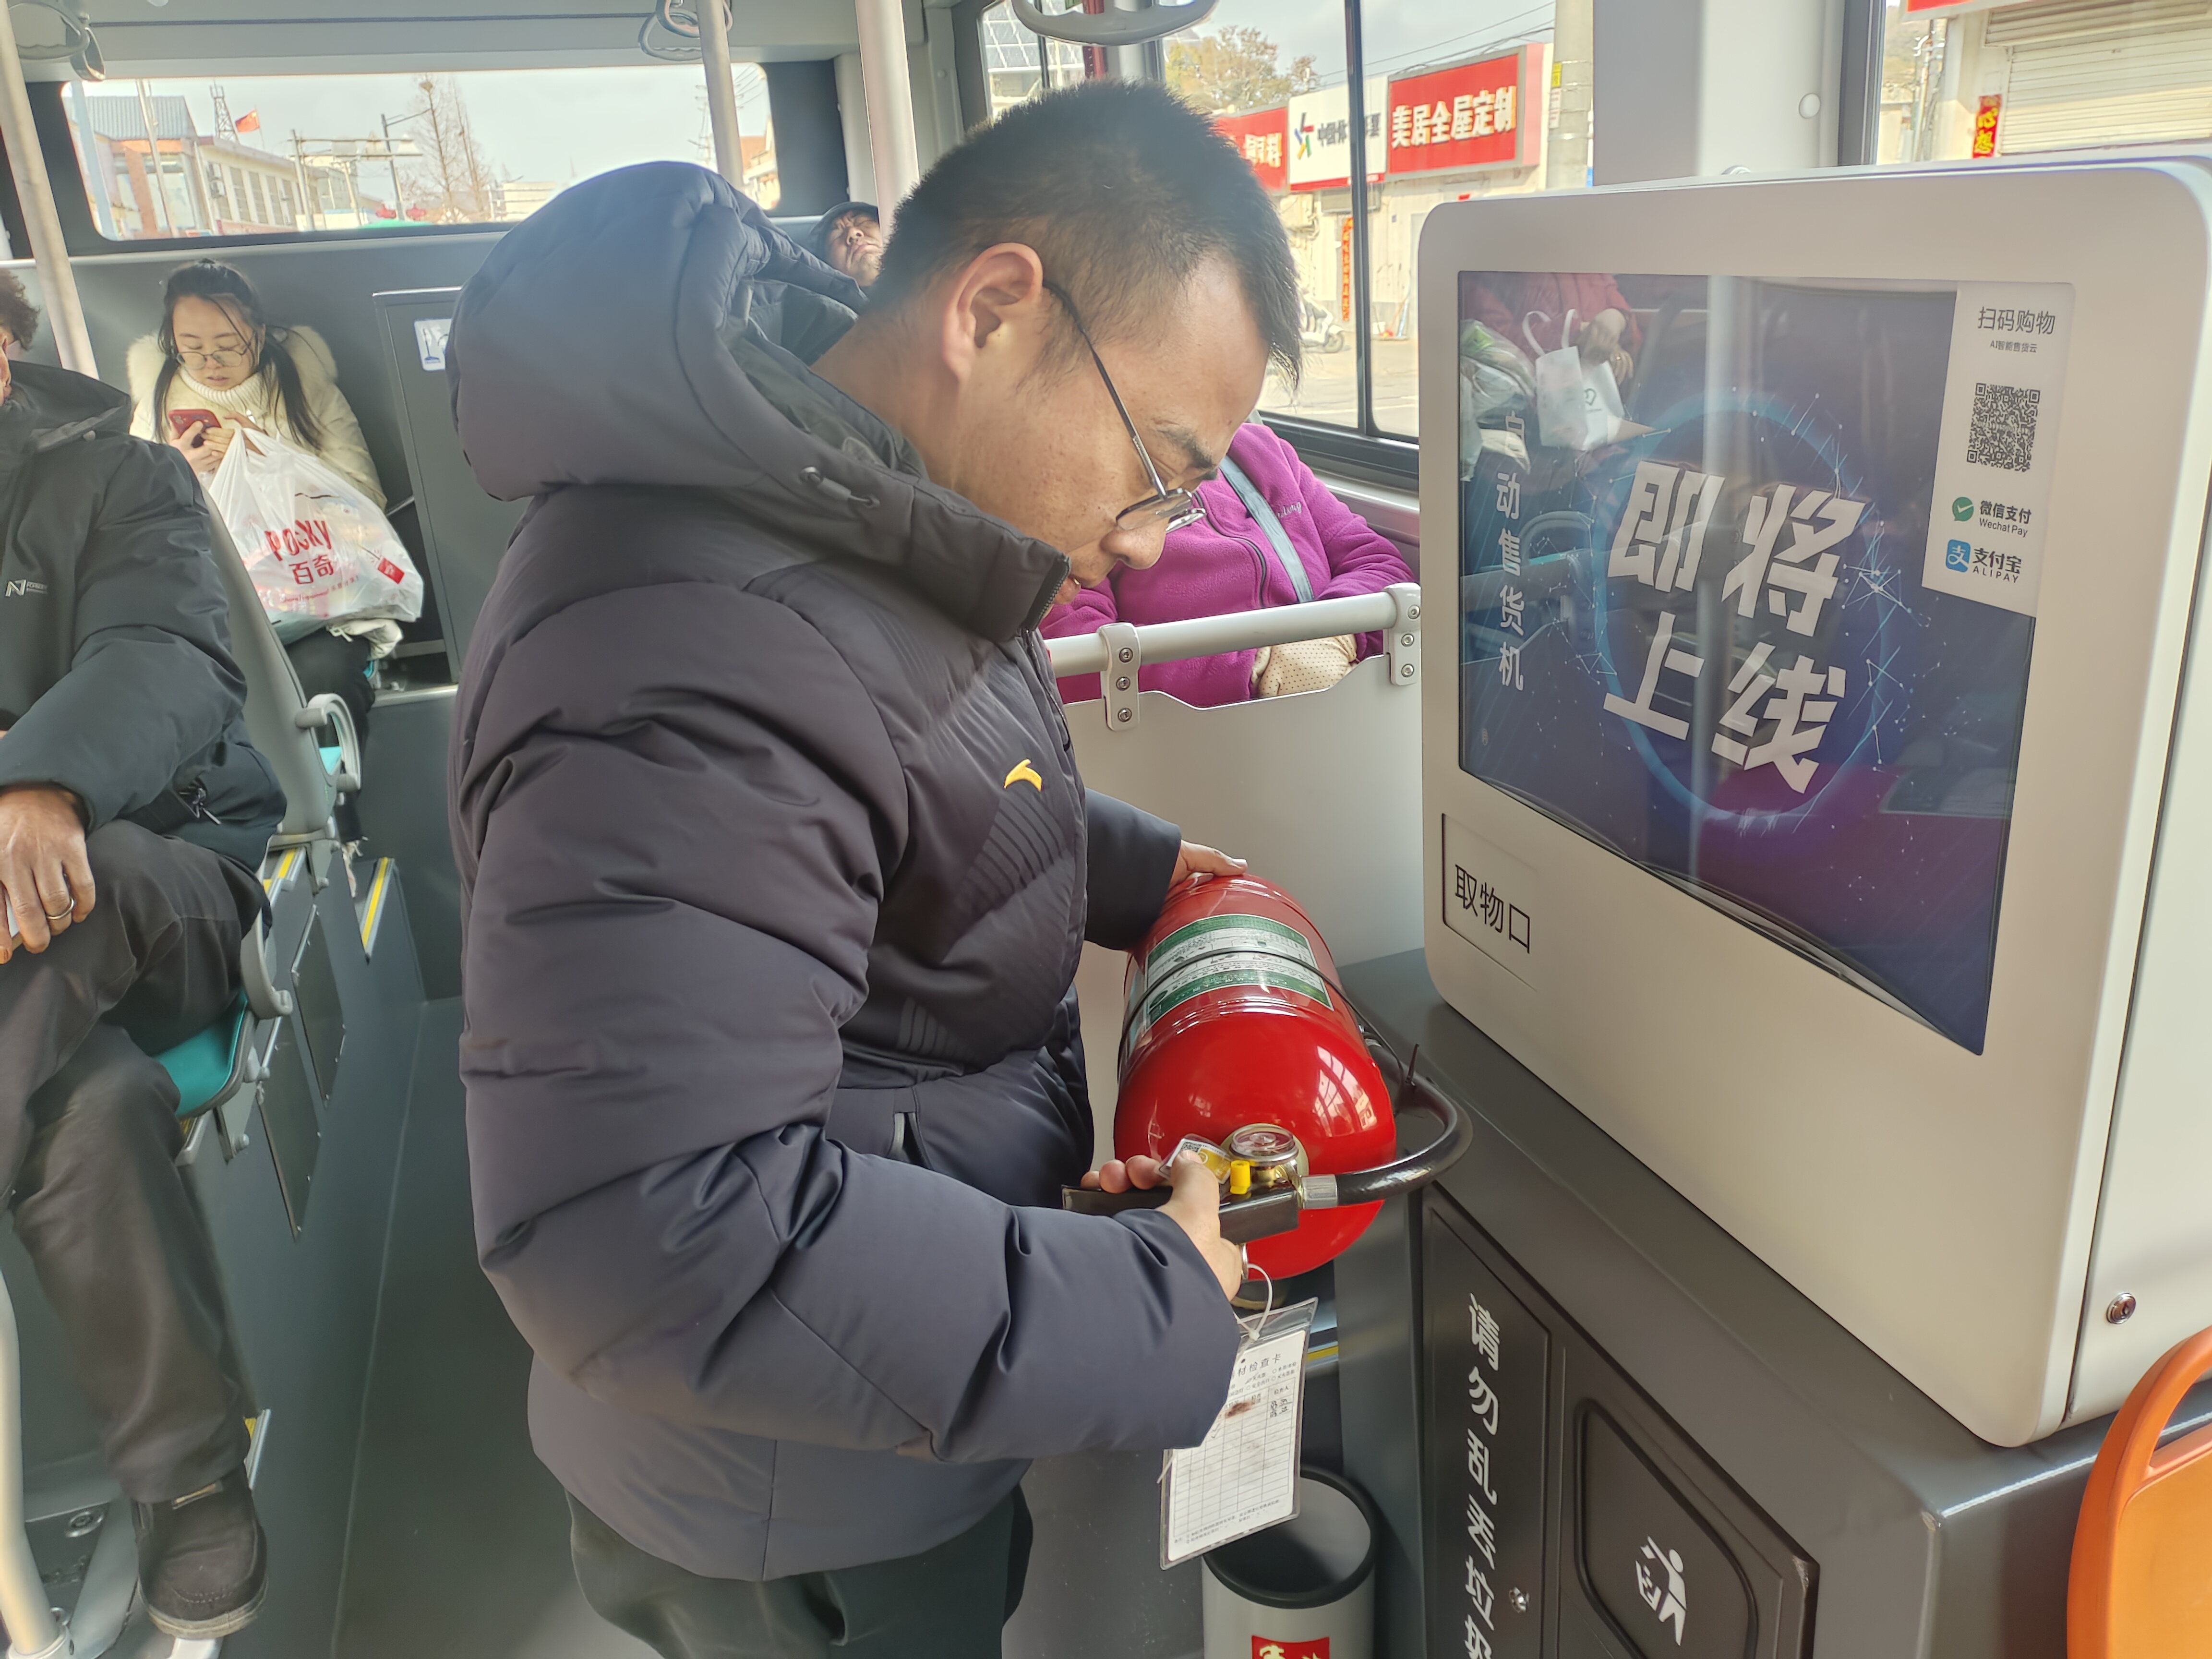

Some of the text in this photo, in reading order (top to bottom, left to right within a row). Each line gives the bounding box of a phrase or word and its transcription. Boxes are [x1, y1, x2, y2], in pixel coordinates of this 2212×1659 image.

[1317, 113, 1381, 147] 中国体票
[1391, 85, 1517, 149] 美居全屋定制
[1974, 107, 1998, 157] 心想
[1978, 306, 2056, 335] 扫码购物
[1990, 340, 2037, 353] AI智能售货云
[1979, 517, 2028, 538] Wechat Pay
[1980, 500, 2032, 524] 微信支付
[1608, 461, 1866, 637] 即将
[1972, 548, 2022, 574] 支付宝
[289, 554, 334, 585] 百奇
[1973, 565, 2019, 584] ALIPAY
[1603, 611, 1847, 794] 上线
[1455, 864, 1530, 954] 取物口
[1231, 1353, 1281, 1379] 材检查卡
[1465, 1293, 1500, 1659] 请勿乱丢垃圾
